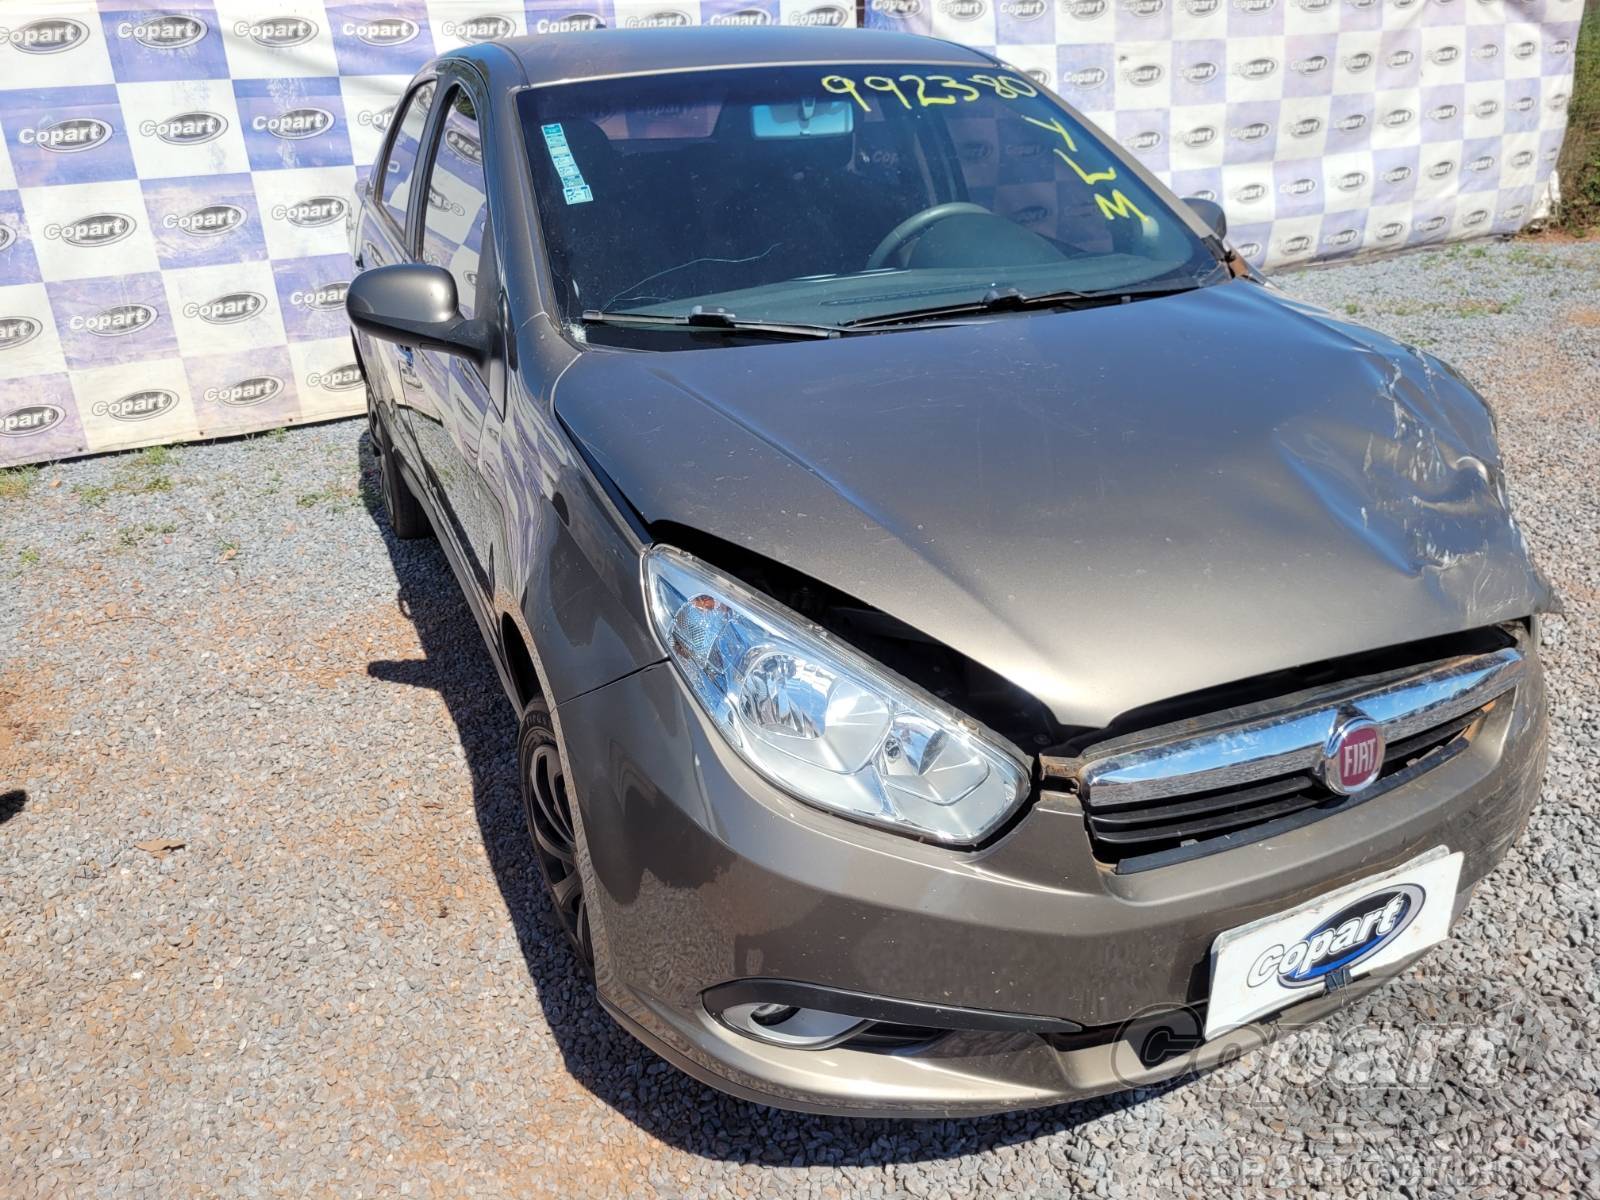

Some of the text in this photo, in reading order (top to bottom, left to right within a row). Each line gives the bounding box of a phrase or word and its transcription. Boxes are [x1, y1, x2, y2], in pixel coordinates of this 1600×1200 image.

[940, 0, 982, 14] Copart
[1000, 0, 1043, 14] Copart
[536, 19, 596, 34] Copart
[789, 11, 842, 27] Copart
[0, 25, 76, 46] Copart
[118, 21, 196, 42] Copart
[234, 21, 309, 39] Copart
[342, 22, 410, 39] Copart
[442, 21, 507, 37] Copart
[1290, 57, 1327, 72] Copart
[1064, 69, 1104, 83] Copart
[140, 119, 217, 138] Copart
[252, 117, 324, 131] Copart
[357, 110, 392, 129] Cop
[18, 125, 101, 146] Copart
[1231, 123, 1268, 139] Copart
[163, 211, 238, 231] Copart
[271, 204, 338, 222] Copart
[44, 219, 123, 240] Copart
[290, 288, 349, 306] Copar
[183, 299, 258, 319] Copart
[0, 318, 33, 338] art
[69, 308, 145, 333] Copart
[306, 368, 361, 387] Copar
[203, 381, 275, 402] Copart
[92, 393, 166, 416] Copart
[0, 409, 53, 432] part
[1343, 738, 1377, 778] FIAT
[1247, 890, 1406, 989] Copart
